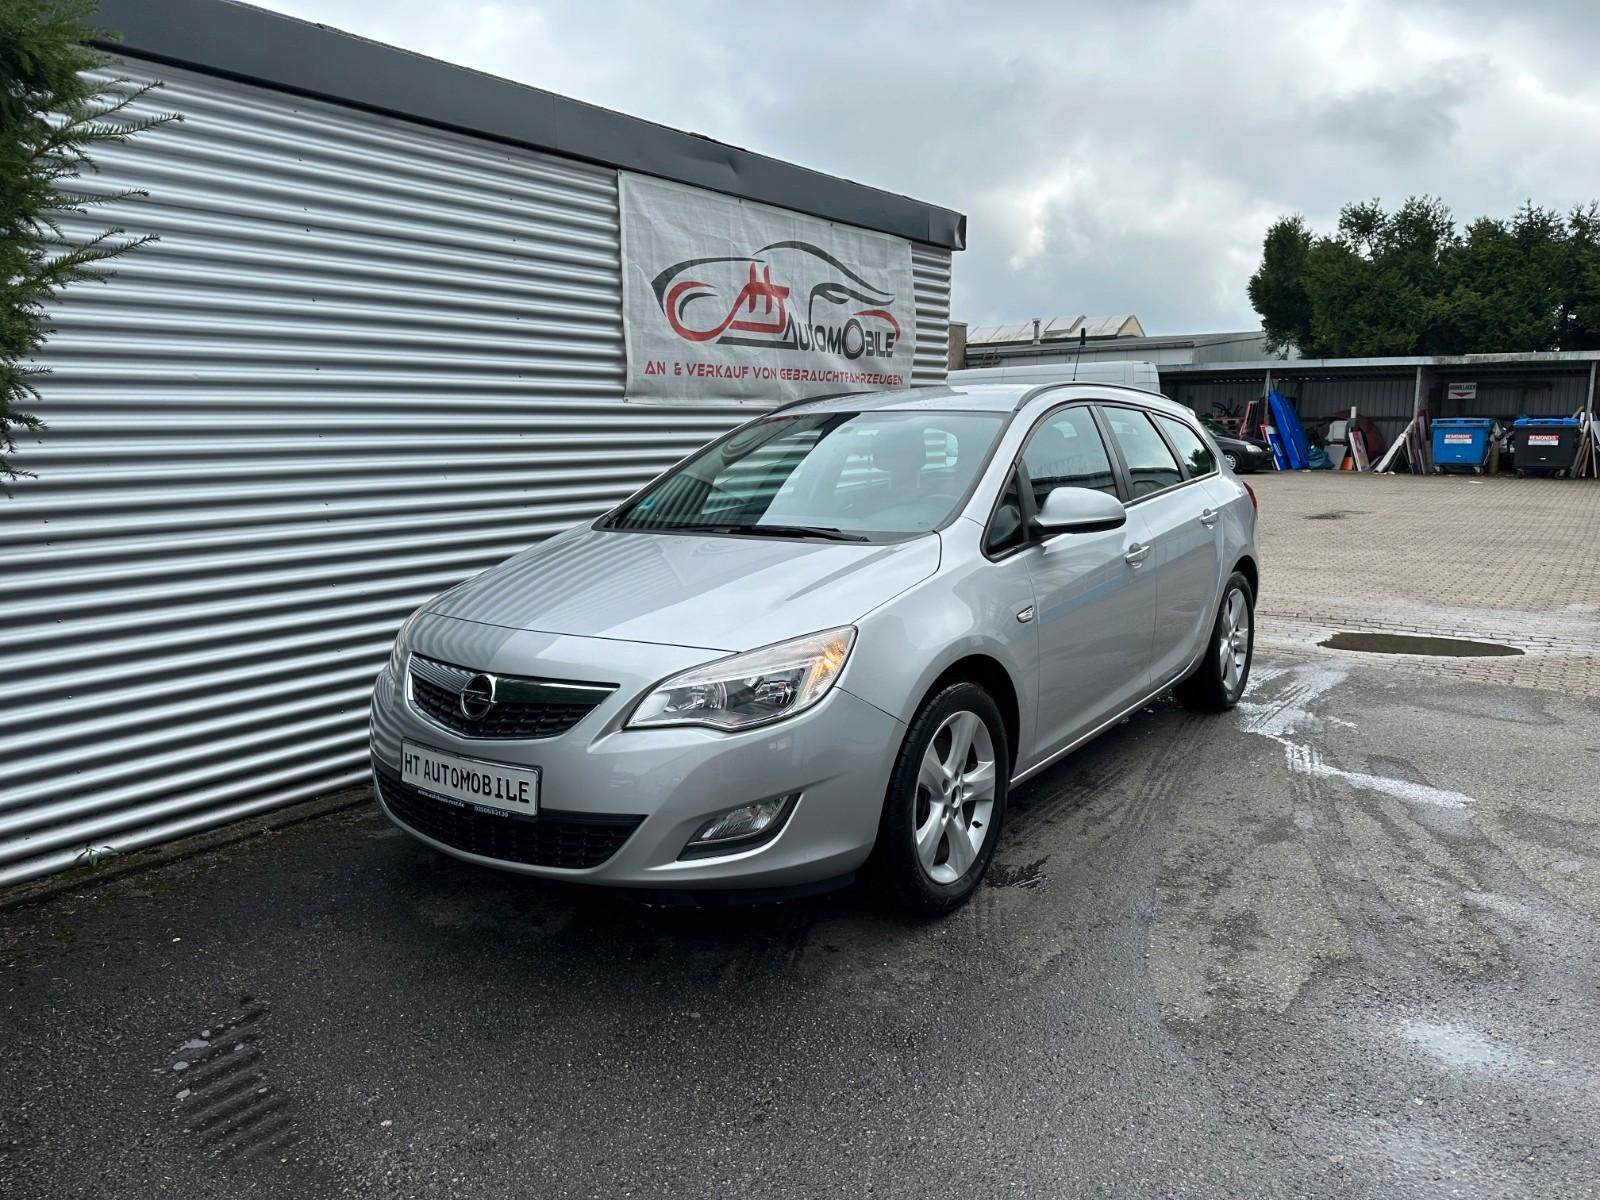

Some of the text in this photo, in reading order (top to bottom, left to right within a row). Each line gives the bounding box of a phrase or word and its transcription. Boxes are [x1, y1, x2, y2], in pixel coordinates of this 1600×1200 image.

[644, 360, 904, 386] AN & VERKAUF VON GEBRAUCHTFAHRZEUGEN
[404, 751, 420, 777] HT
[423, 758, 531, 804] AUTOMOBILE
